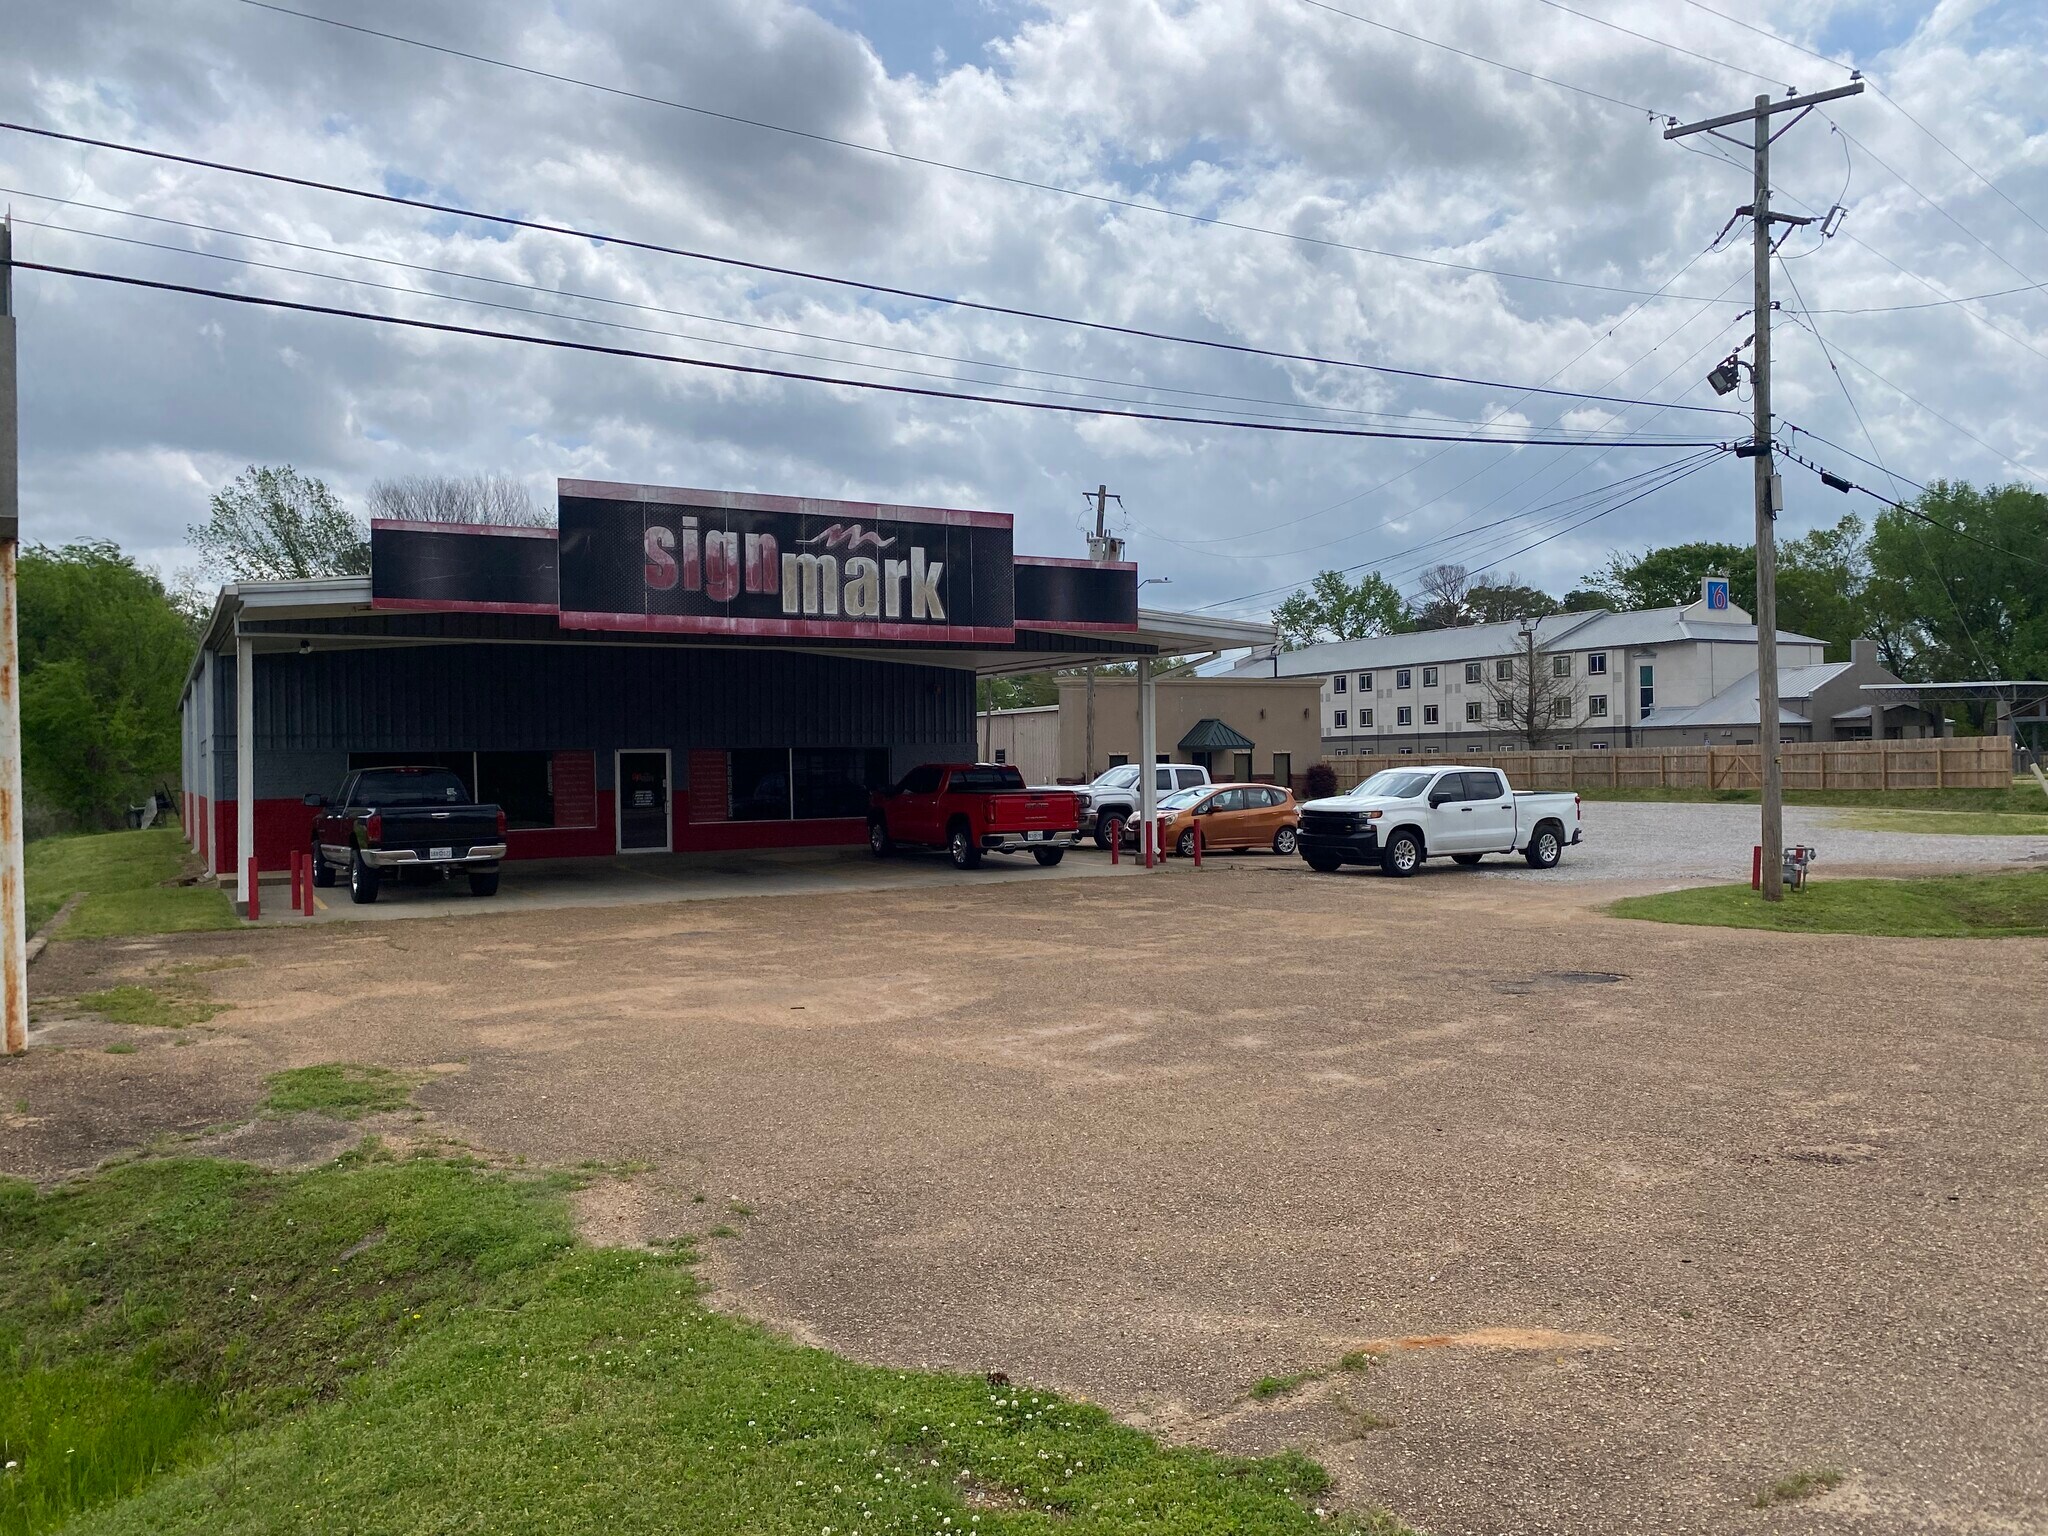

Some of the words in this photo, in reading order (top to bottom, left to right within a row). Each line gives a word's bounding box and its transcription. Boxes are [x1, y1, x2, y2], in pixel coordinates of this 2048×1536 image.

[643, 516, 780, 602] sign
[781, 547, 946, 620] mark
[1713, 584, 1726, 609] 6
